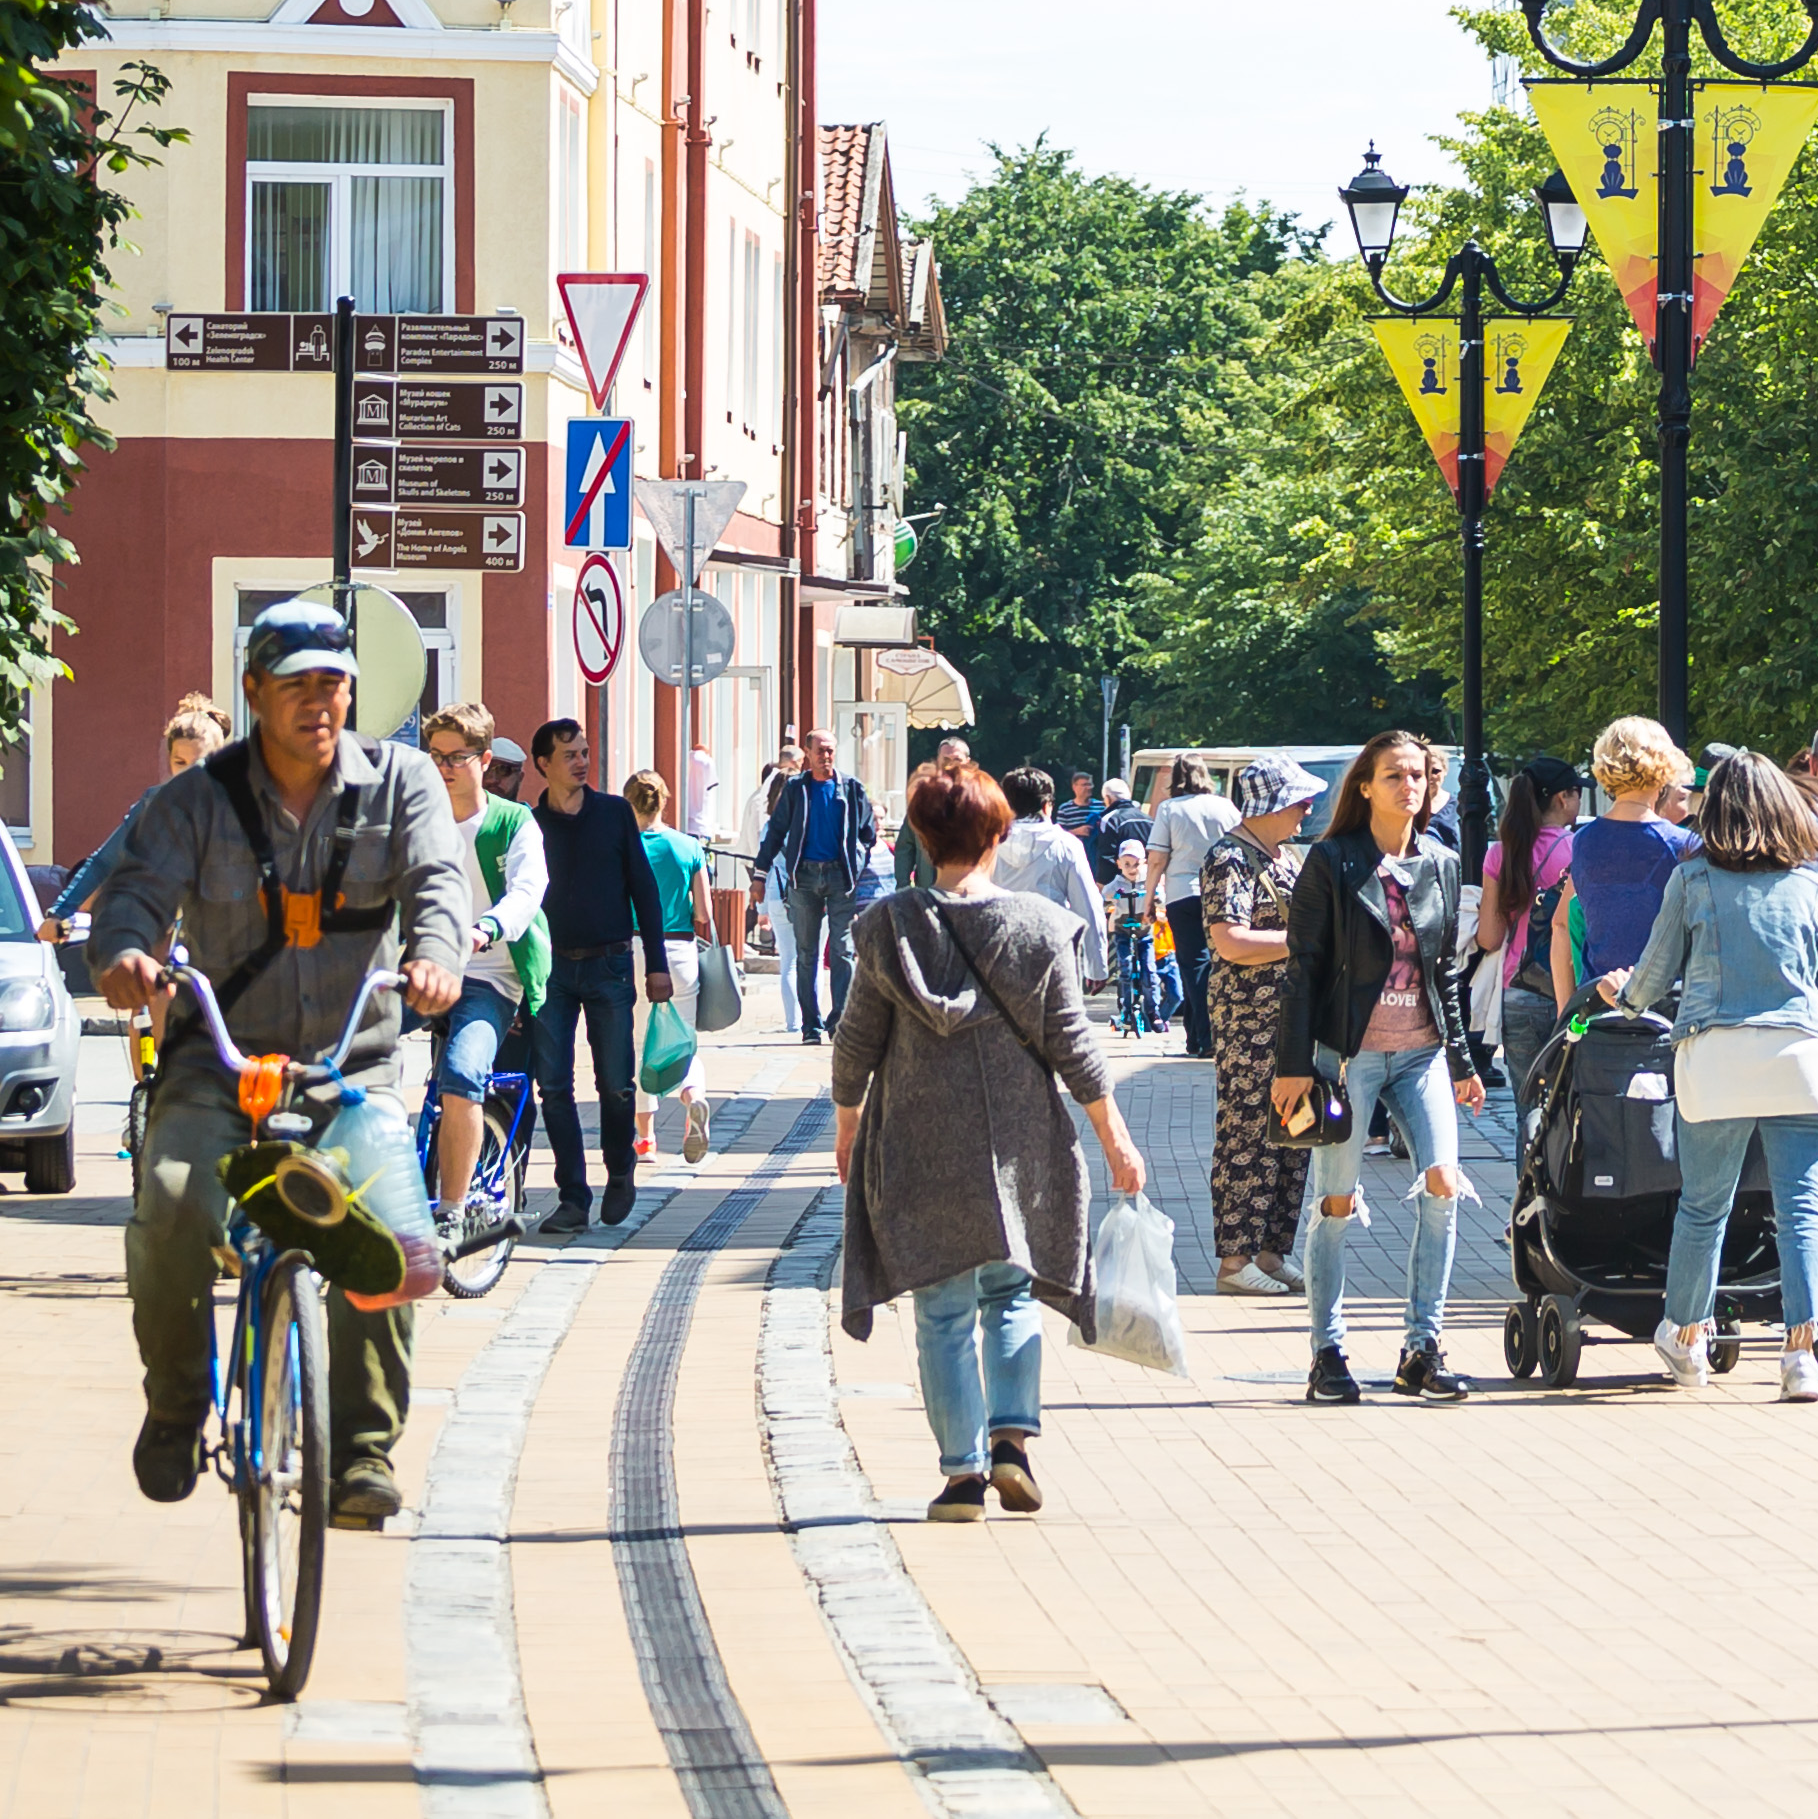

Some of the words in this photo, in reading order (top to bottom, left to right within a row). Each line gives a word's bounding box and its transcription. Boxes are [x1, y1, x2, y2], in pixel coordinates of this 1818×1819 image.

[206, 322, 248, 331] Санаторий
[401, 348, 430, 357] Paradox
[431, 348, 483, 357] Entertainment
[173, 357, 191, 366] 100
[206, 355, 230, 364] Health
[231, 355, 255, 364] Center
[401, 357, 432, 366] Complex
[488, 360, 507, 370] 250
[400, 388, 424, 398] Музей
[399, 414, 435, 422] Murarium
[436, 414, 448, 422] Art
[399, 422, 435, 431] Collection
[436, 422, 445, 431] of
[445, 423, 461, 432] Cats
[487, 426, 505, 435] 250
[398, 454, 423, 464] Музей
[425, 457, 457, 465] черепов
[398, 479, 429, 487] Museum
[430, 479, 438, 487] of
[398, 488, 419, 496] Skulls
[420, 488, 434, 496] and
[435, 488, 471, 497] Skeletons
[485, 492, 504, 501] 250
[397, 518, 422, 528] Музей
[396, 543, 410, 552] The
[411, 543, 432, 552] Home
[433, 544, 442, 552] of
[442, 544, 468, 555] Angels
[396, 552, 427, 561] Museum
[485, 557, 504, 566] 400
